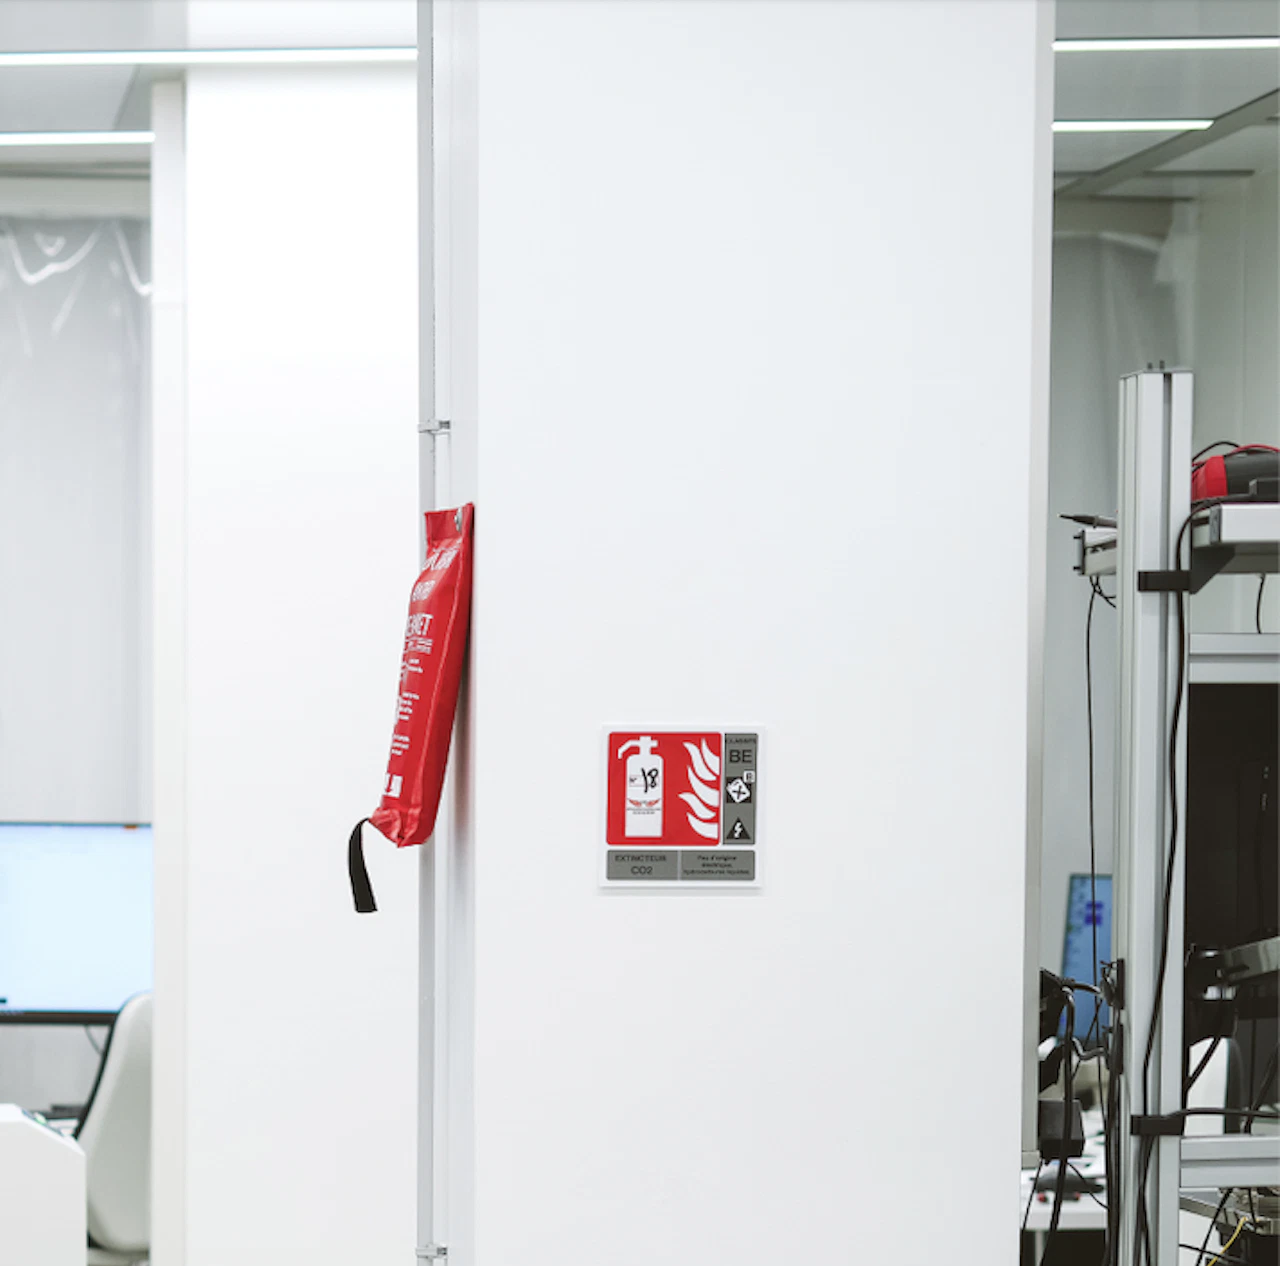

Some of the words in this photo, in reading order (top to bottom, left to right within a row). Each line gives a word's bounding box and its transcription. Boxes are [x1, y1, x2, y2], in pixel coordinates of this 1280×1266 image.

[729, 749, 752, 763] BE
[641, 767, 659, 793] 18
[631, 866, 653, 874] CO2
